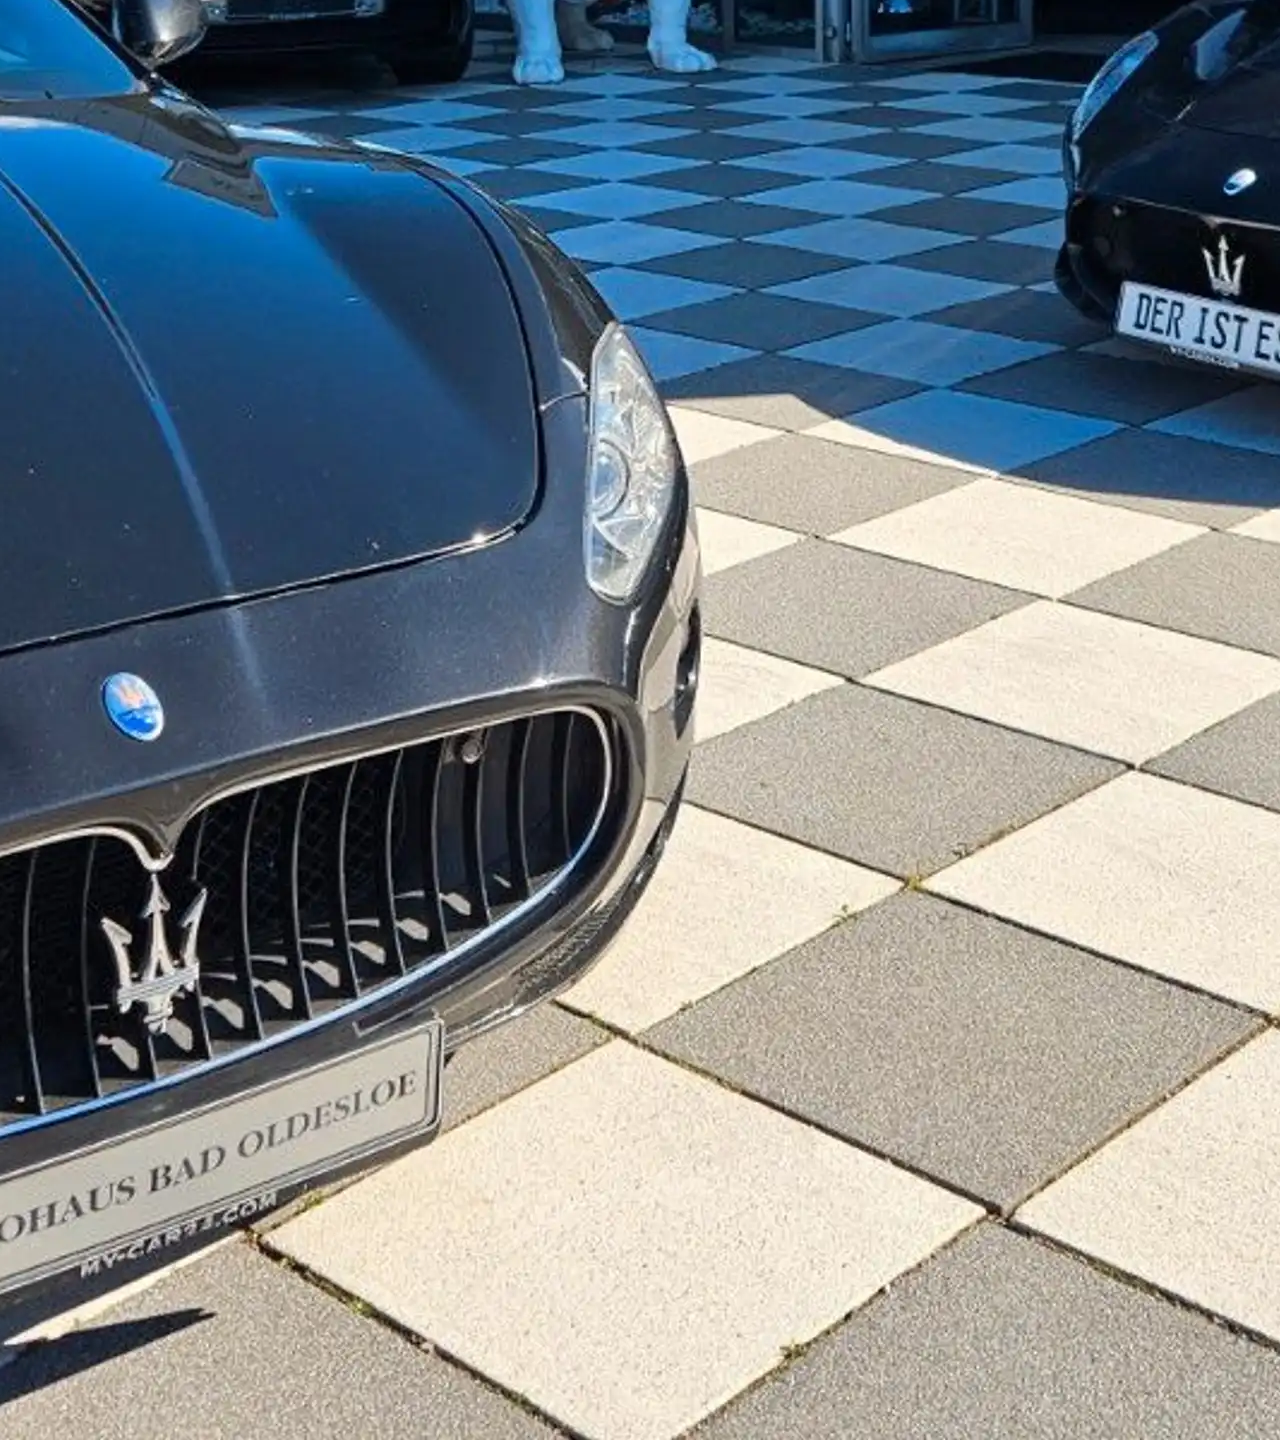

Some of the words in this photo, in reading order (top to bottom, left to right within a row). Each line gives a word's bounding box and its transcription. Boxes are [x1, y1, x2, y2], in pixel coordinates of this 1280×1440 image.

[1133, 293, 1184, 339] DER
[1192, 307, 1250, 354] IST
[148, 1145, 227, 1194] BAD
[236, 1070, 417, 1155] OLDESLOE
